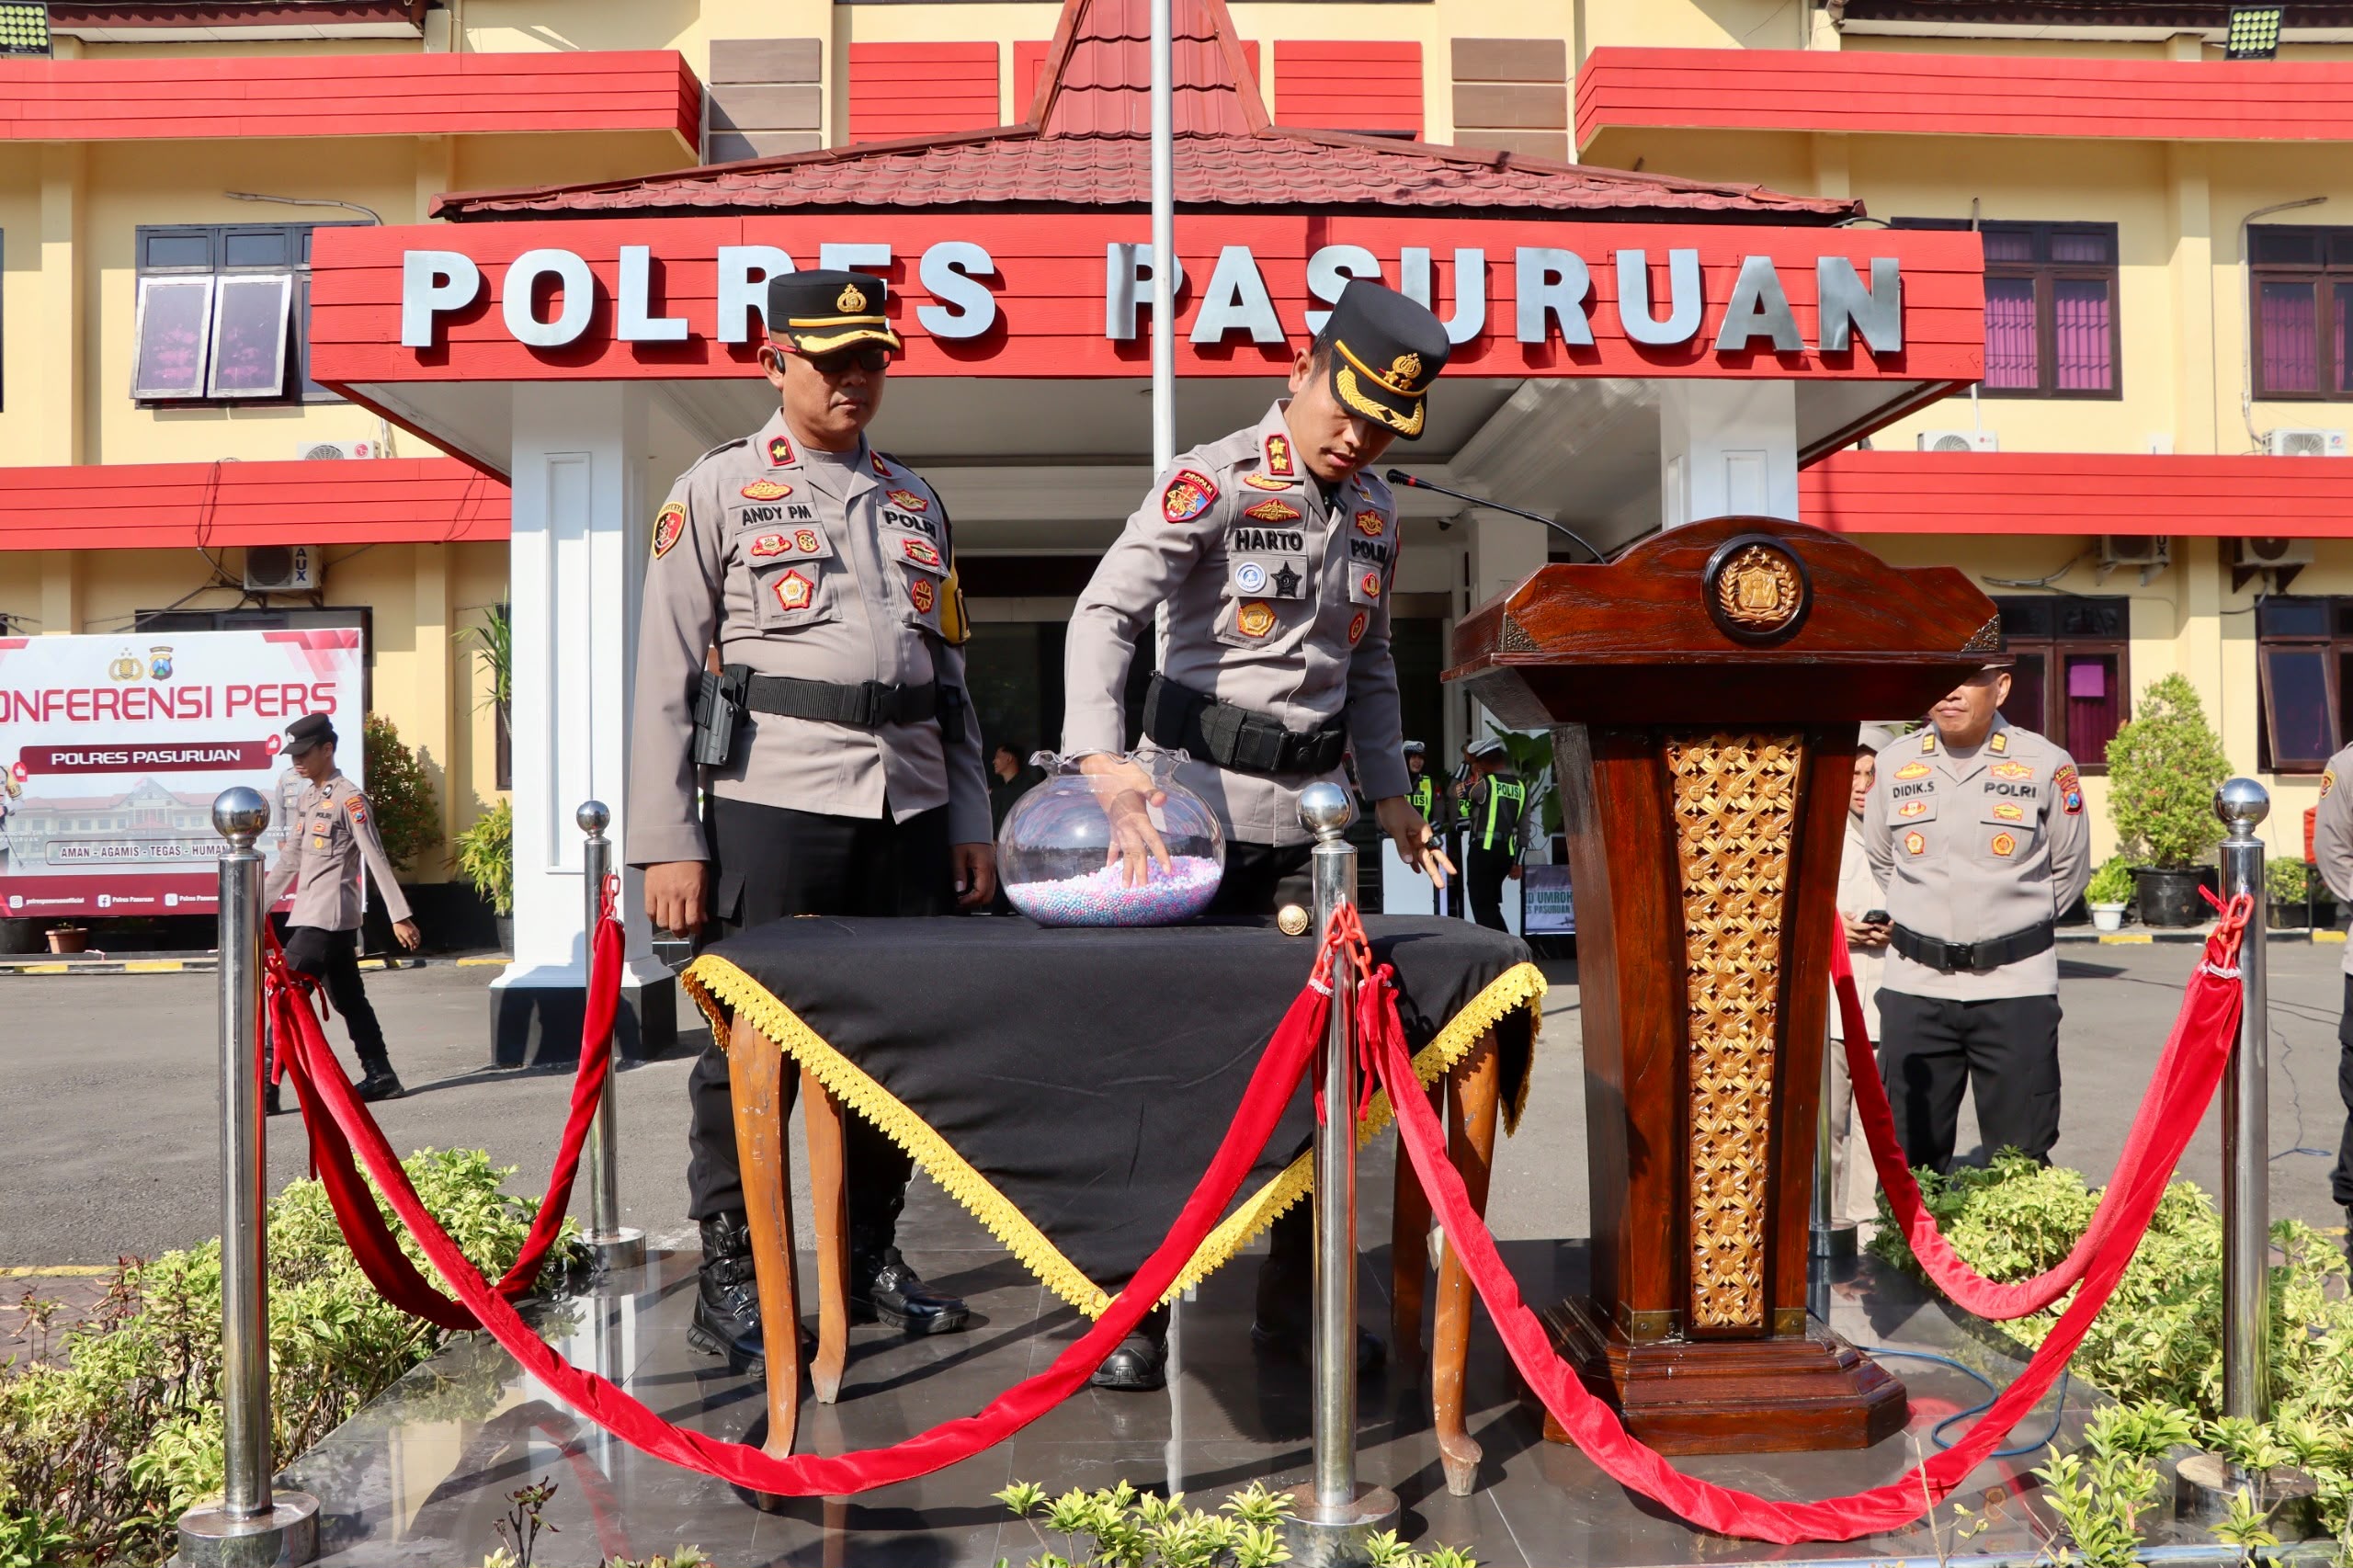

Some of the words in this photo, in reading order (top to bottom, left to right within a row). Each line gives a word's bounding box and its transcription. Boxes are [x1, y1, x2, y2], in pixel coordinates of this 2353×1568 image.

[401, 240, 995, 347] POLRS
[1106, 242, 1902, 352] PASURUAN
[1184, 472, 1213, 494] PROPAM
[743, 506, 781, 526] ANDY
[788, 506, 812, 518] PM
[1235, 528, 1303, 551] HARTO
[296, 548, 307, 581] AUX
[226, 683, 336, 717] PERS
[51, 752, 128, 765] POLRES
[133, 749, 241, 764] PASURUAN
[1496, 783, 1521, 799] POLISI
[1893, 781, 1935, 798] DIDIK.S
[1984, 781, 2037, 798] POLRI
[61, 847, 90, 858] AMAN
[101, 846, 140, 857] AGAMIS
[151, 846, 181, 856] TEGAS
[1538, 892, 1574, 904] UMROH
